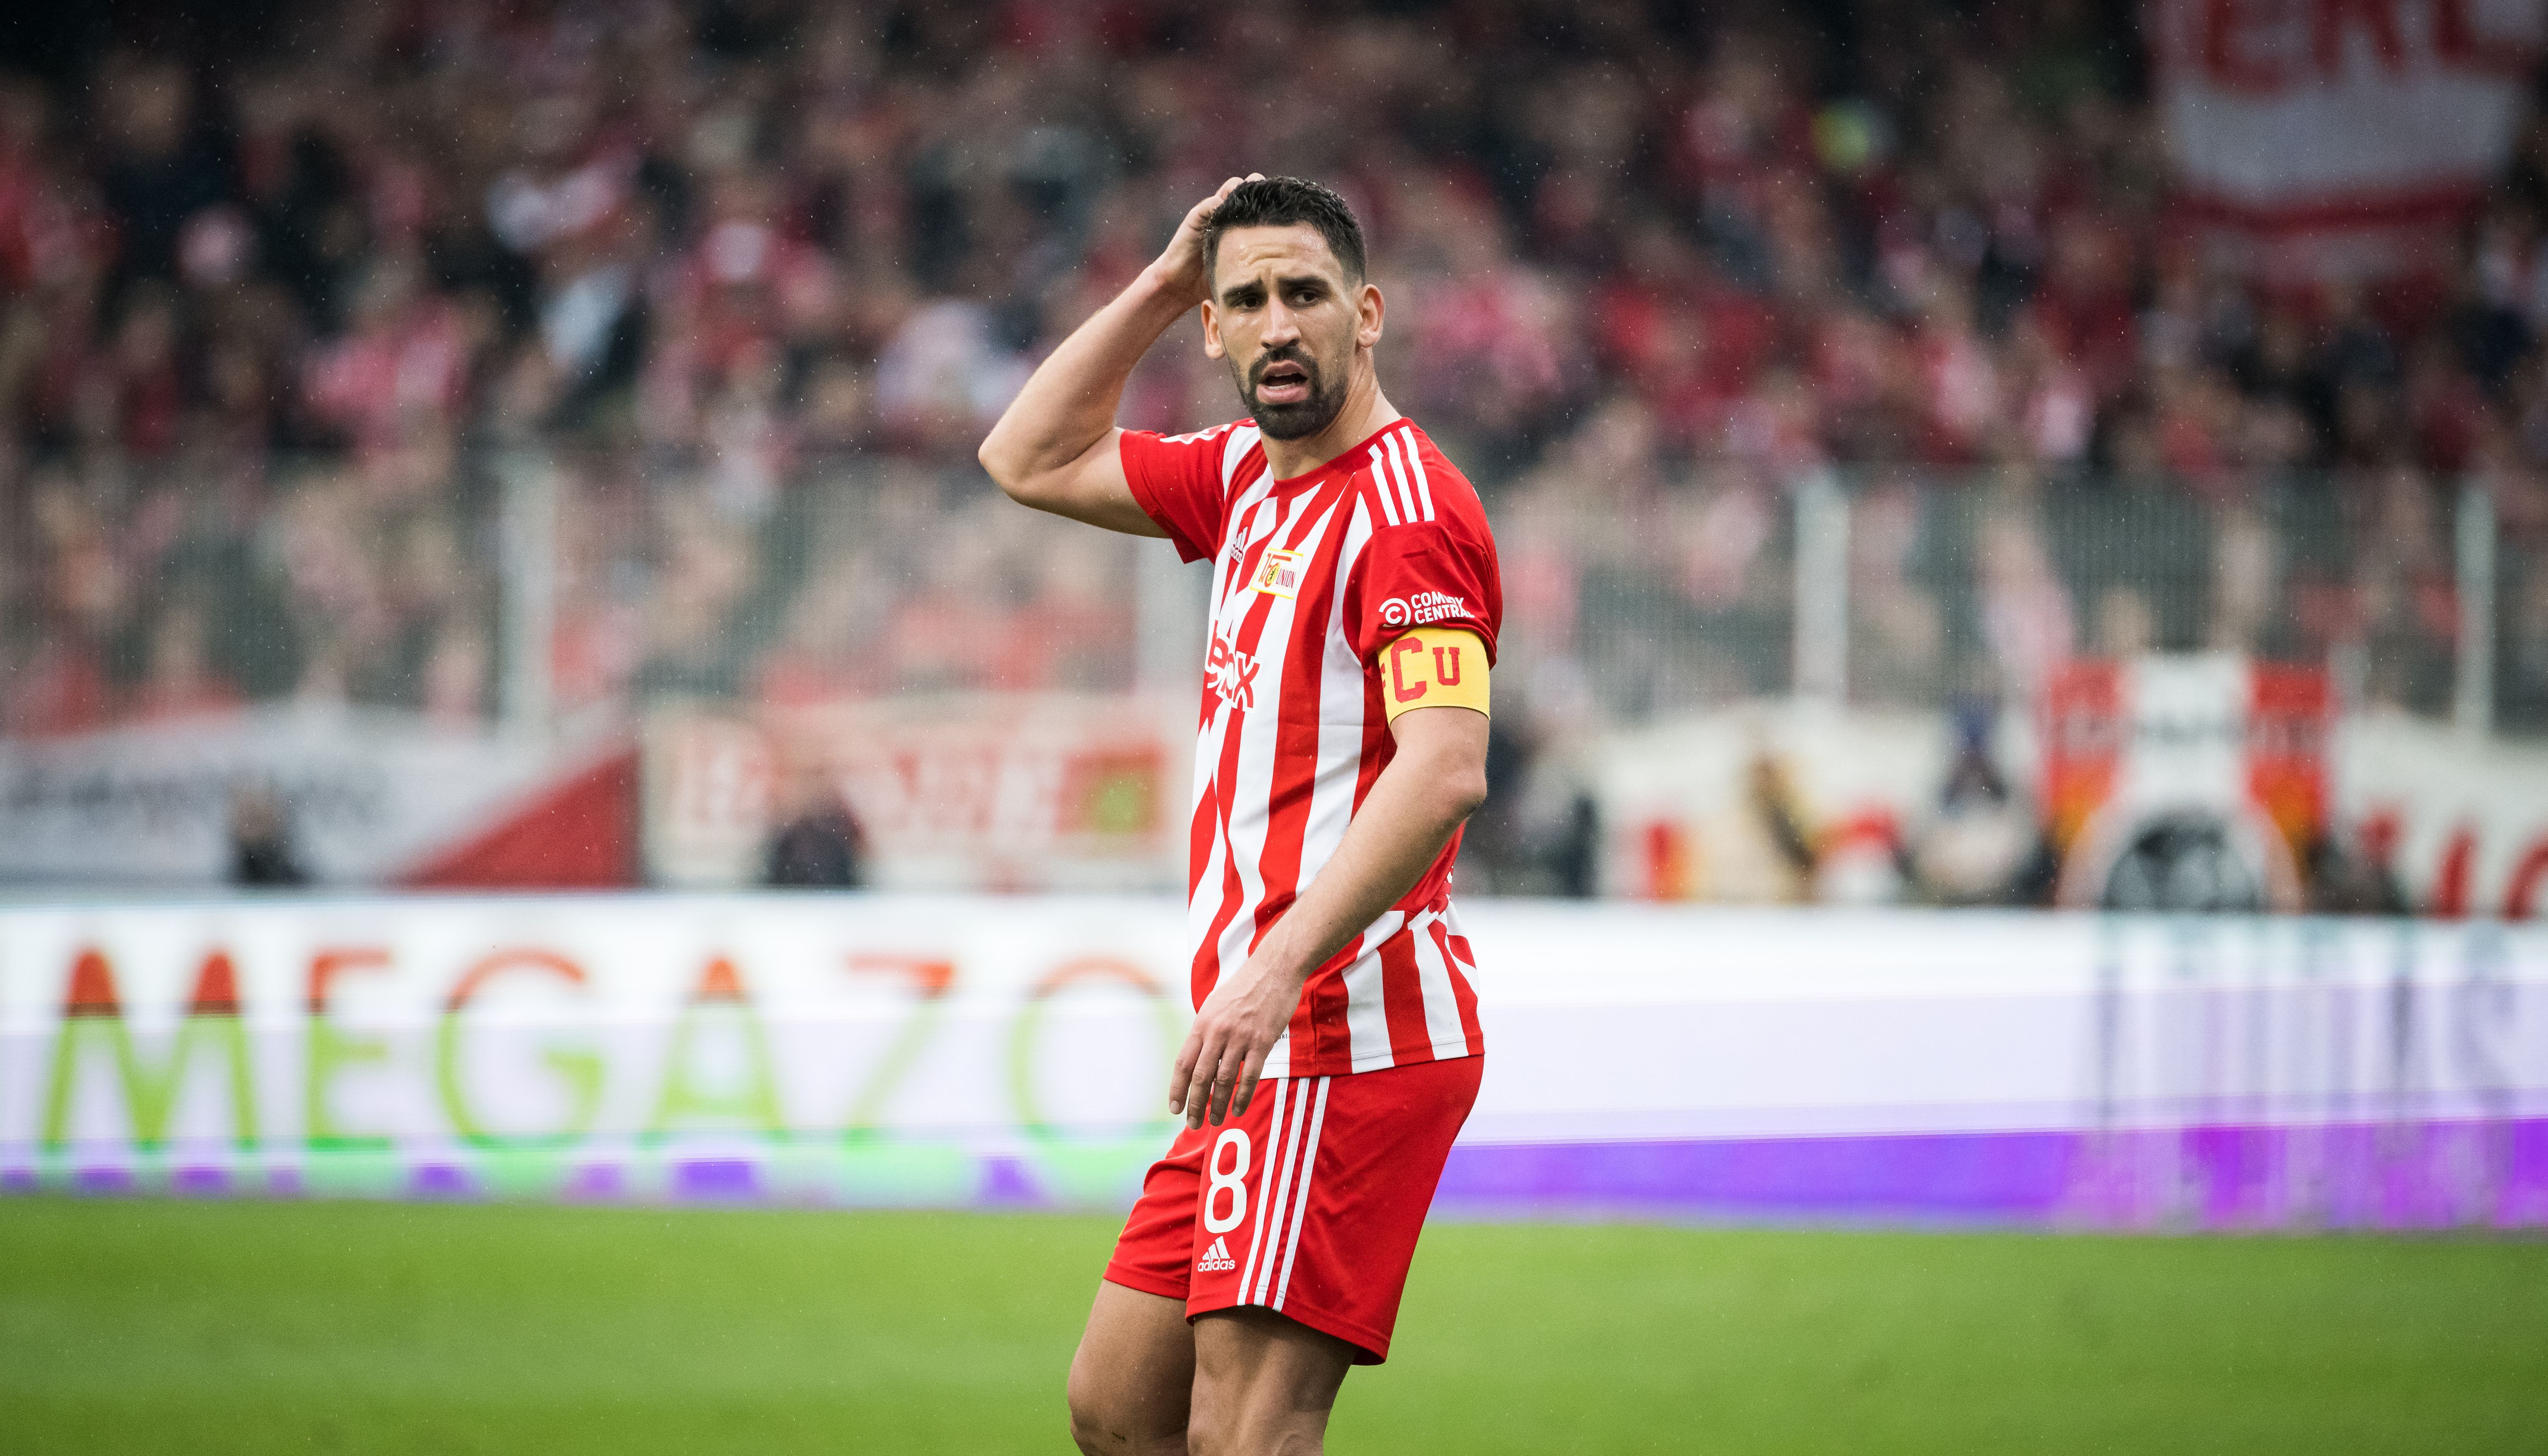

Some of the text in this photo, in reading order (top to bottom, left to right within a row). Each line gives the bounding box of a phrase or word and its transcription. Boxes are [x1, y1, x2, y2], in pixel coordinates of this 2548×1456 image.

[1276, 568, 1296, 589] UNION
[1415, 604, 1475, 624] CENTRAL
[1204, 1128, 1251, 1233] 8
[1198, 1258, 1235, 1272] adidas
